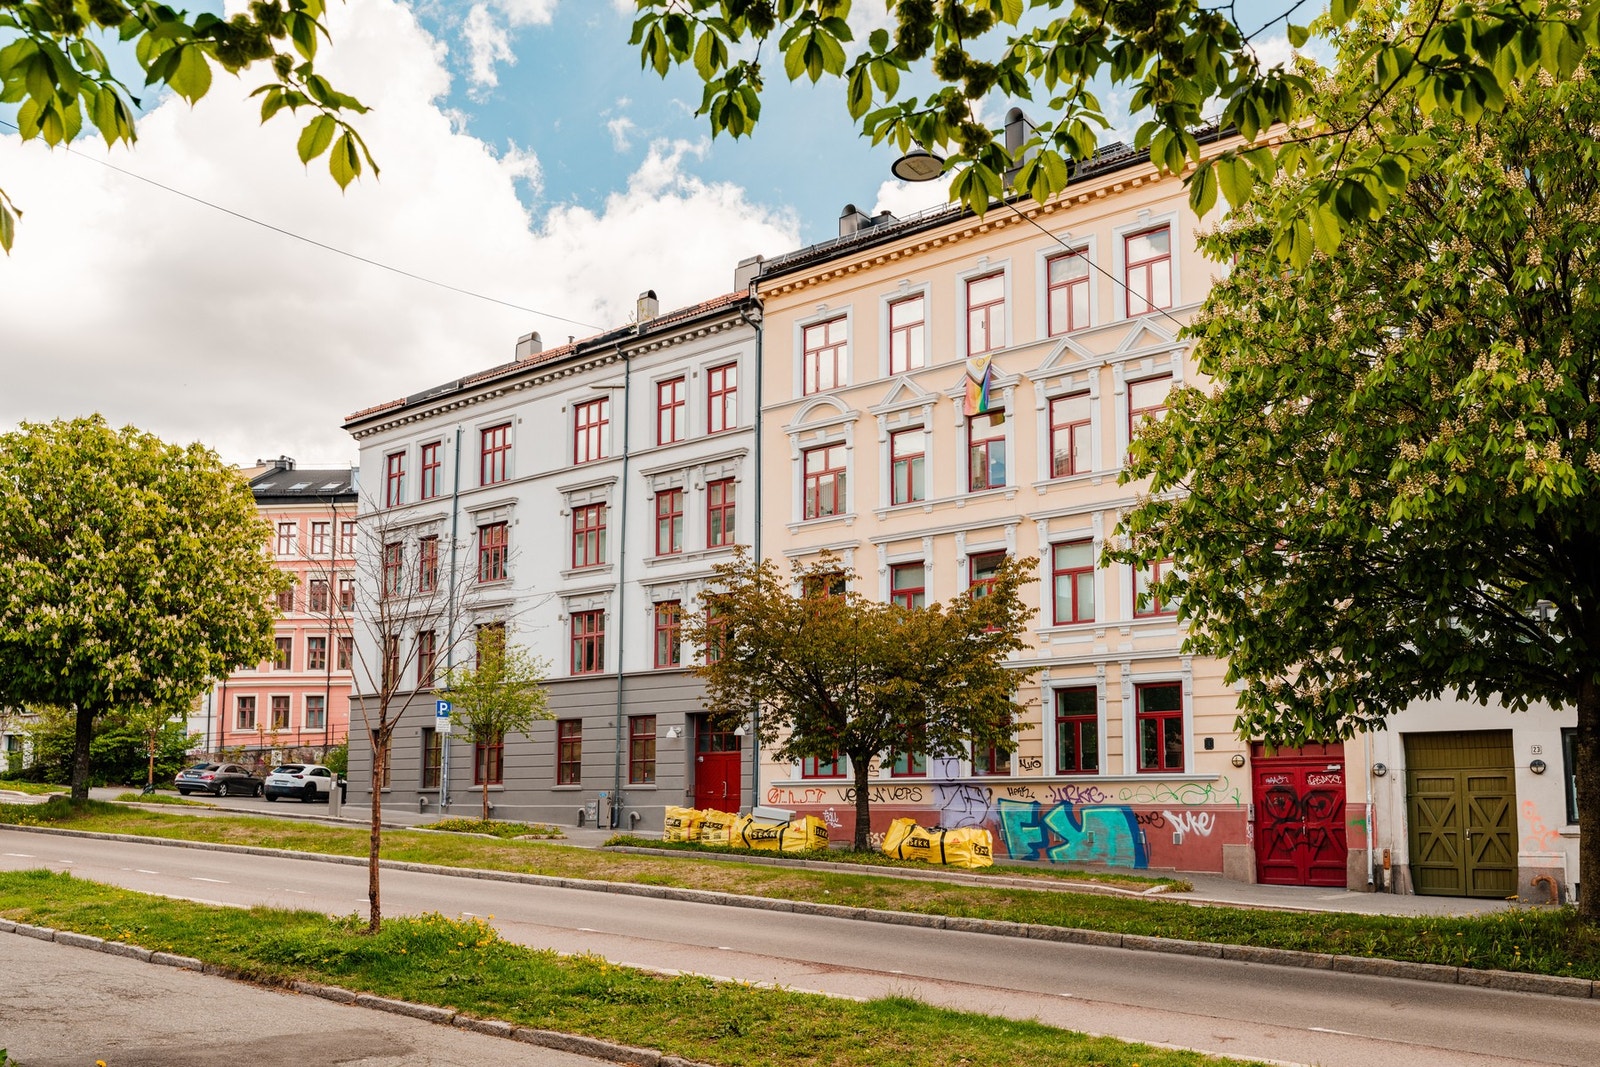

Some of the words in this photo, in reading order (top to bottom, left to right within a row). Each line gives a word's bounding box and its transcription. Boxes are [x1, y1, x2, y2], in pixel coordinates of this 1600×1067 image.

[440, 703, 448, 715] P
[752, 830, 776, 839] SEKK
[816, 827, 828, 838] SEKK
[910, 838, 929, 847] SEKK
